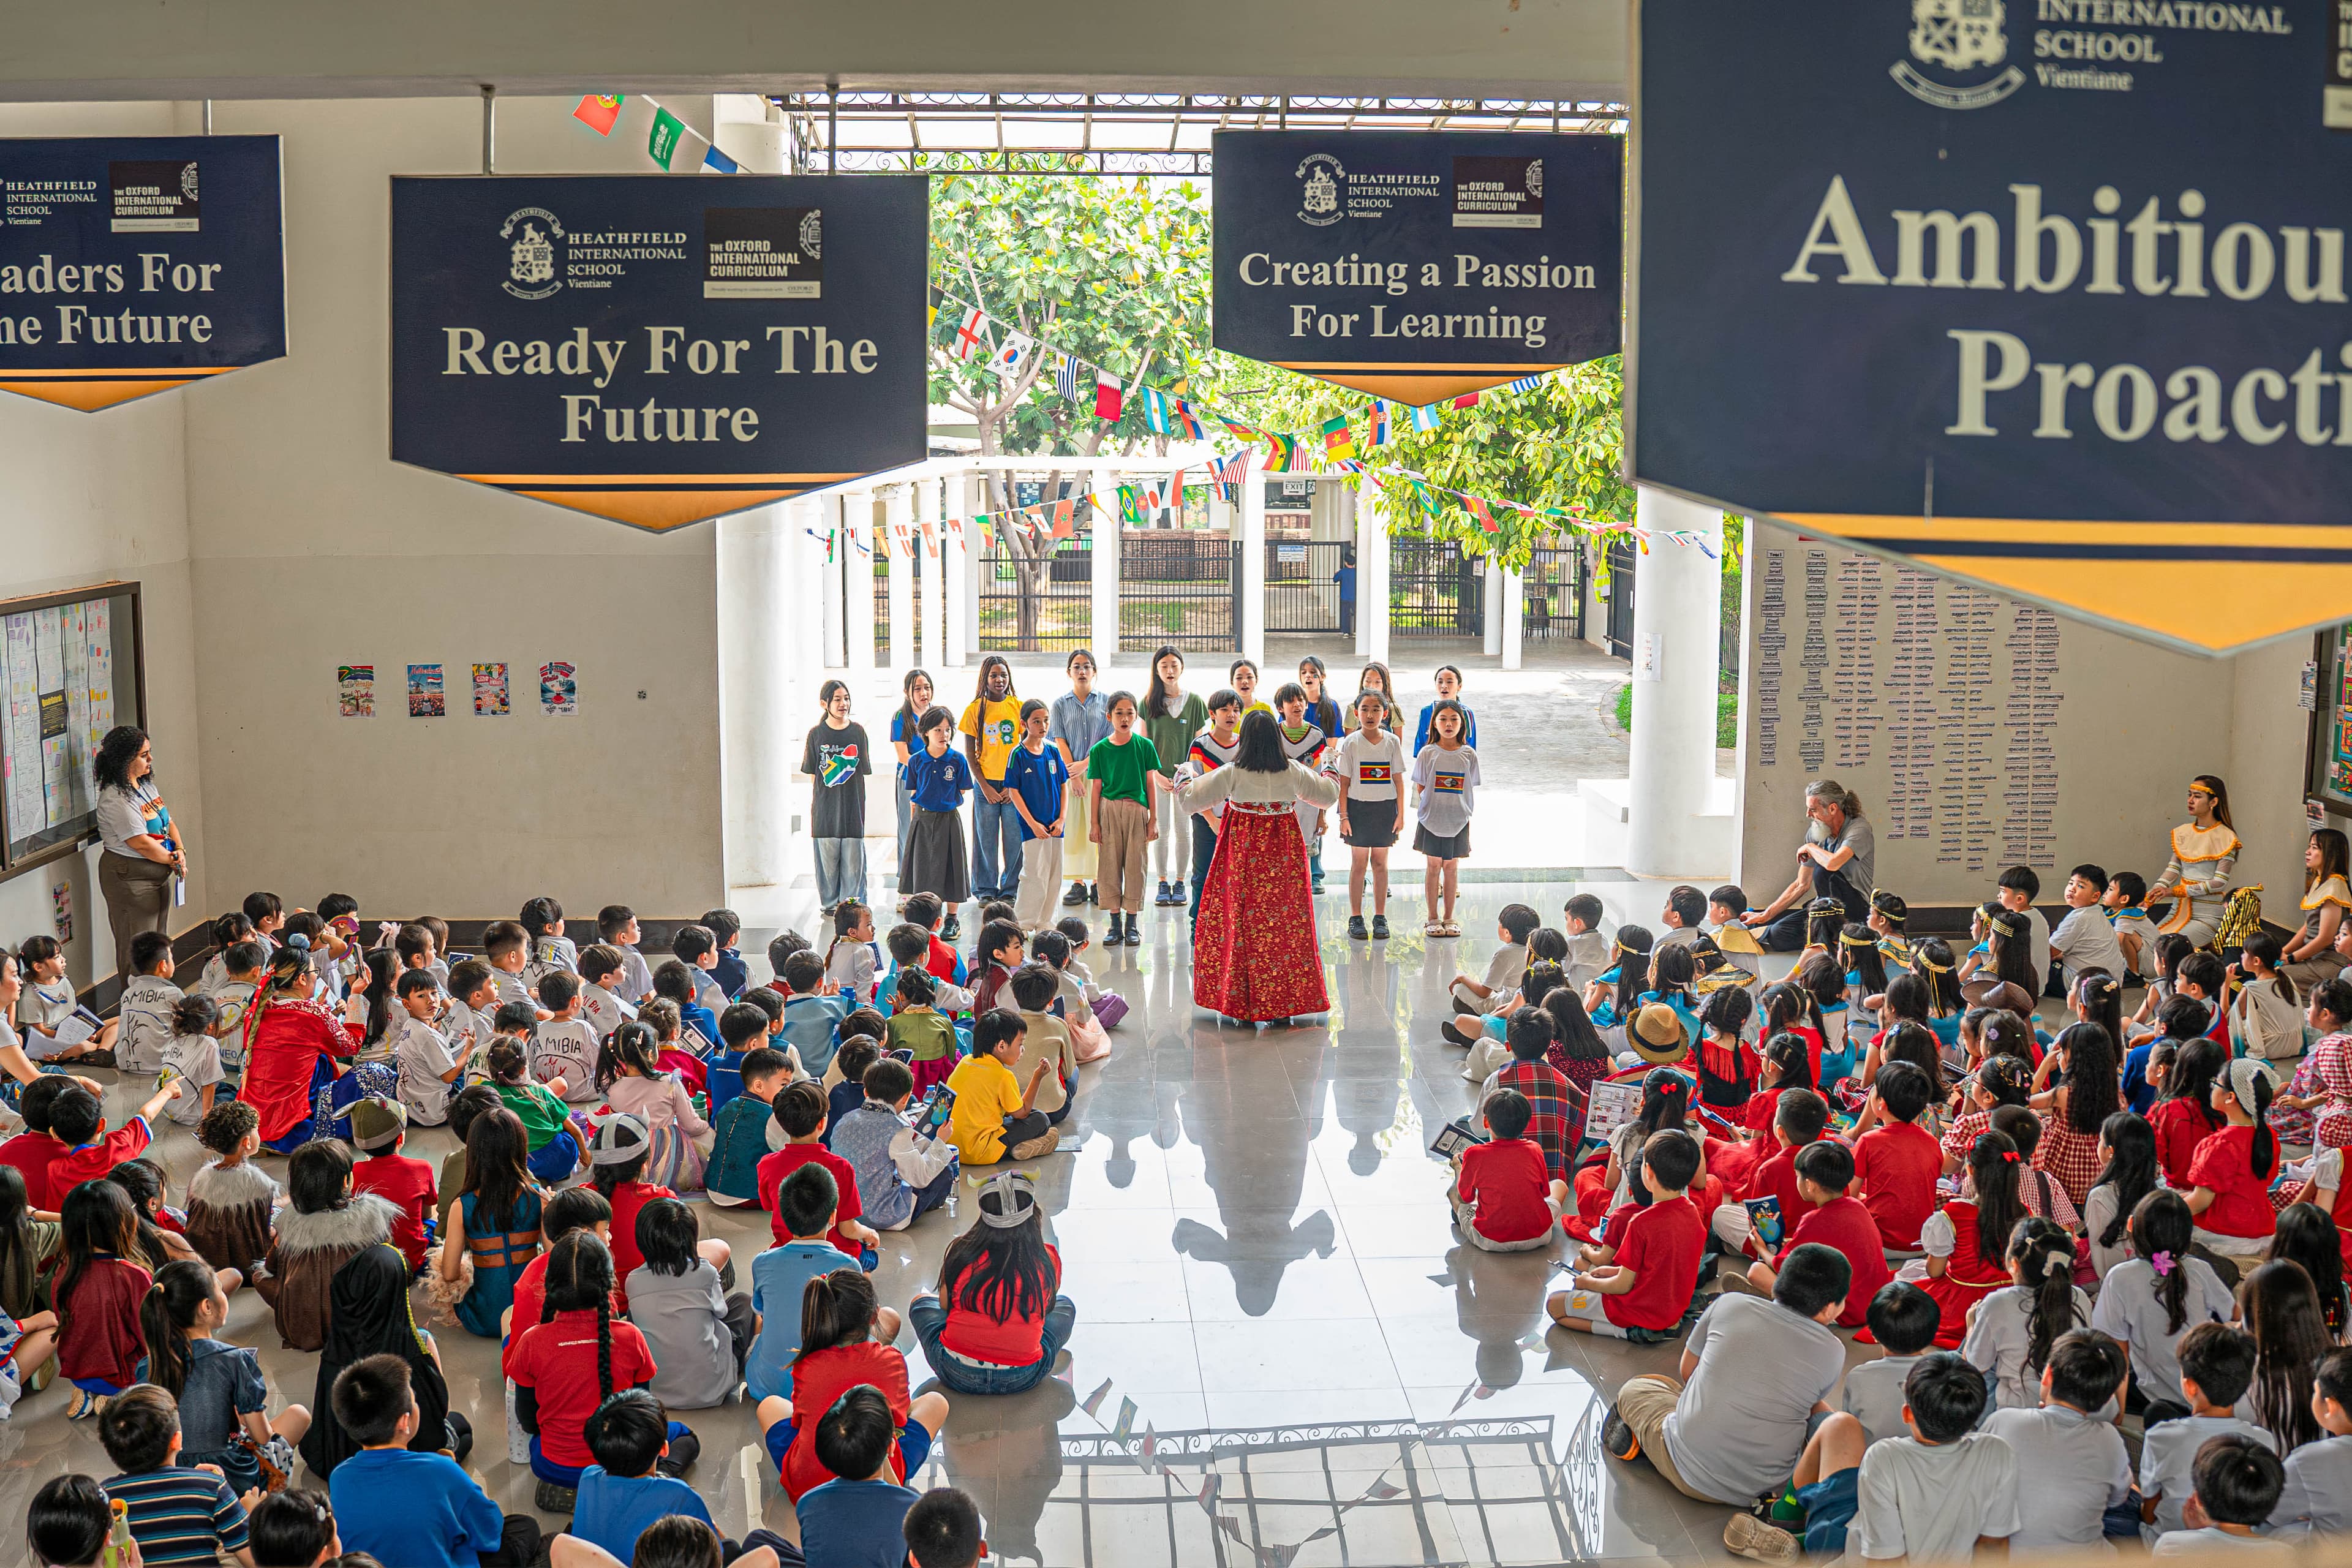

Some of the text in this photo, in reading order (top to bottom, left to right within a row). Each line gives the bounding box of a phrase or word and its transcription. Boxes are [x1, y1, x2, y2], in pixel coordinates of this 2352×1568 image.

[2037, 0, 2293, 34] INTERNATIONAL
[2034, 30, 2163, 62] SCHOOL
[2034, 62, 2133, 91] Vientiane
[1348, 175, 1440, 184] HEATHFIELD
[7, 181, 97, 190] HEATHFIELD
[126, 187, 160, 195] OXFORD
[1469, 183, 1504, 191] OXFORD
[1349, 187, 1439, 196] INTERNATIONAL
[1458, 192, 1526, 201] INTERNATIONAL
[7, 194, 97, 203] INTERNATIONAL
[115, 196, 183, 205] INTERNATIONAL
[1348, 199, 1393, 208] SCHOOL
[7, 206, 51, 214] SCHOOL
[115, 206, 173, 215] CURRICULUM
[1458, 202, 1517, 211] CURRICULUM
[568, 233, 687, 244] HEATHFIELD
[1782, 175, 2348, 303] Ambitiou
[710, 241, 771, 252] THE OXFORD
[568, 248, 686, 260] INTERNATIONAL
[710, 253, 800, 265] INTERNATIONAL
[138, 253, 222, 292] For
[568, 264, 625, 276] SCHOOL
[710, 266, 788, 277] CURRICULUM
[1239, 252, 1596, 296] Creating a Passion
[568, 279, 612, 288] Vientiane
[56, 306, 212, 344] Future
[1289, 304, 1547, 349] For Learning
[442, 326, 878, 388] Ready For The
[560, 394, 759, 442] Future
